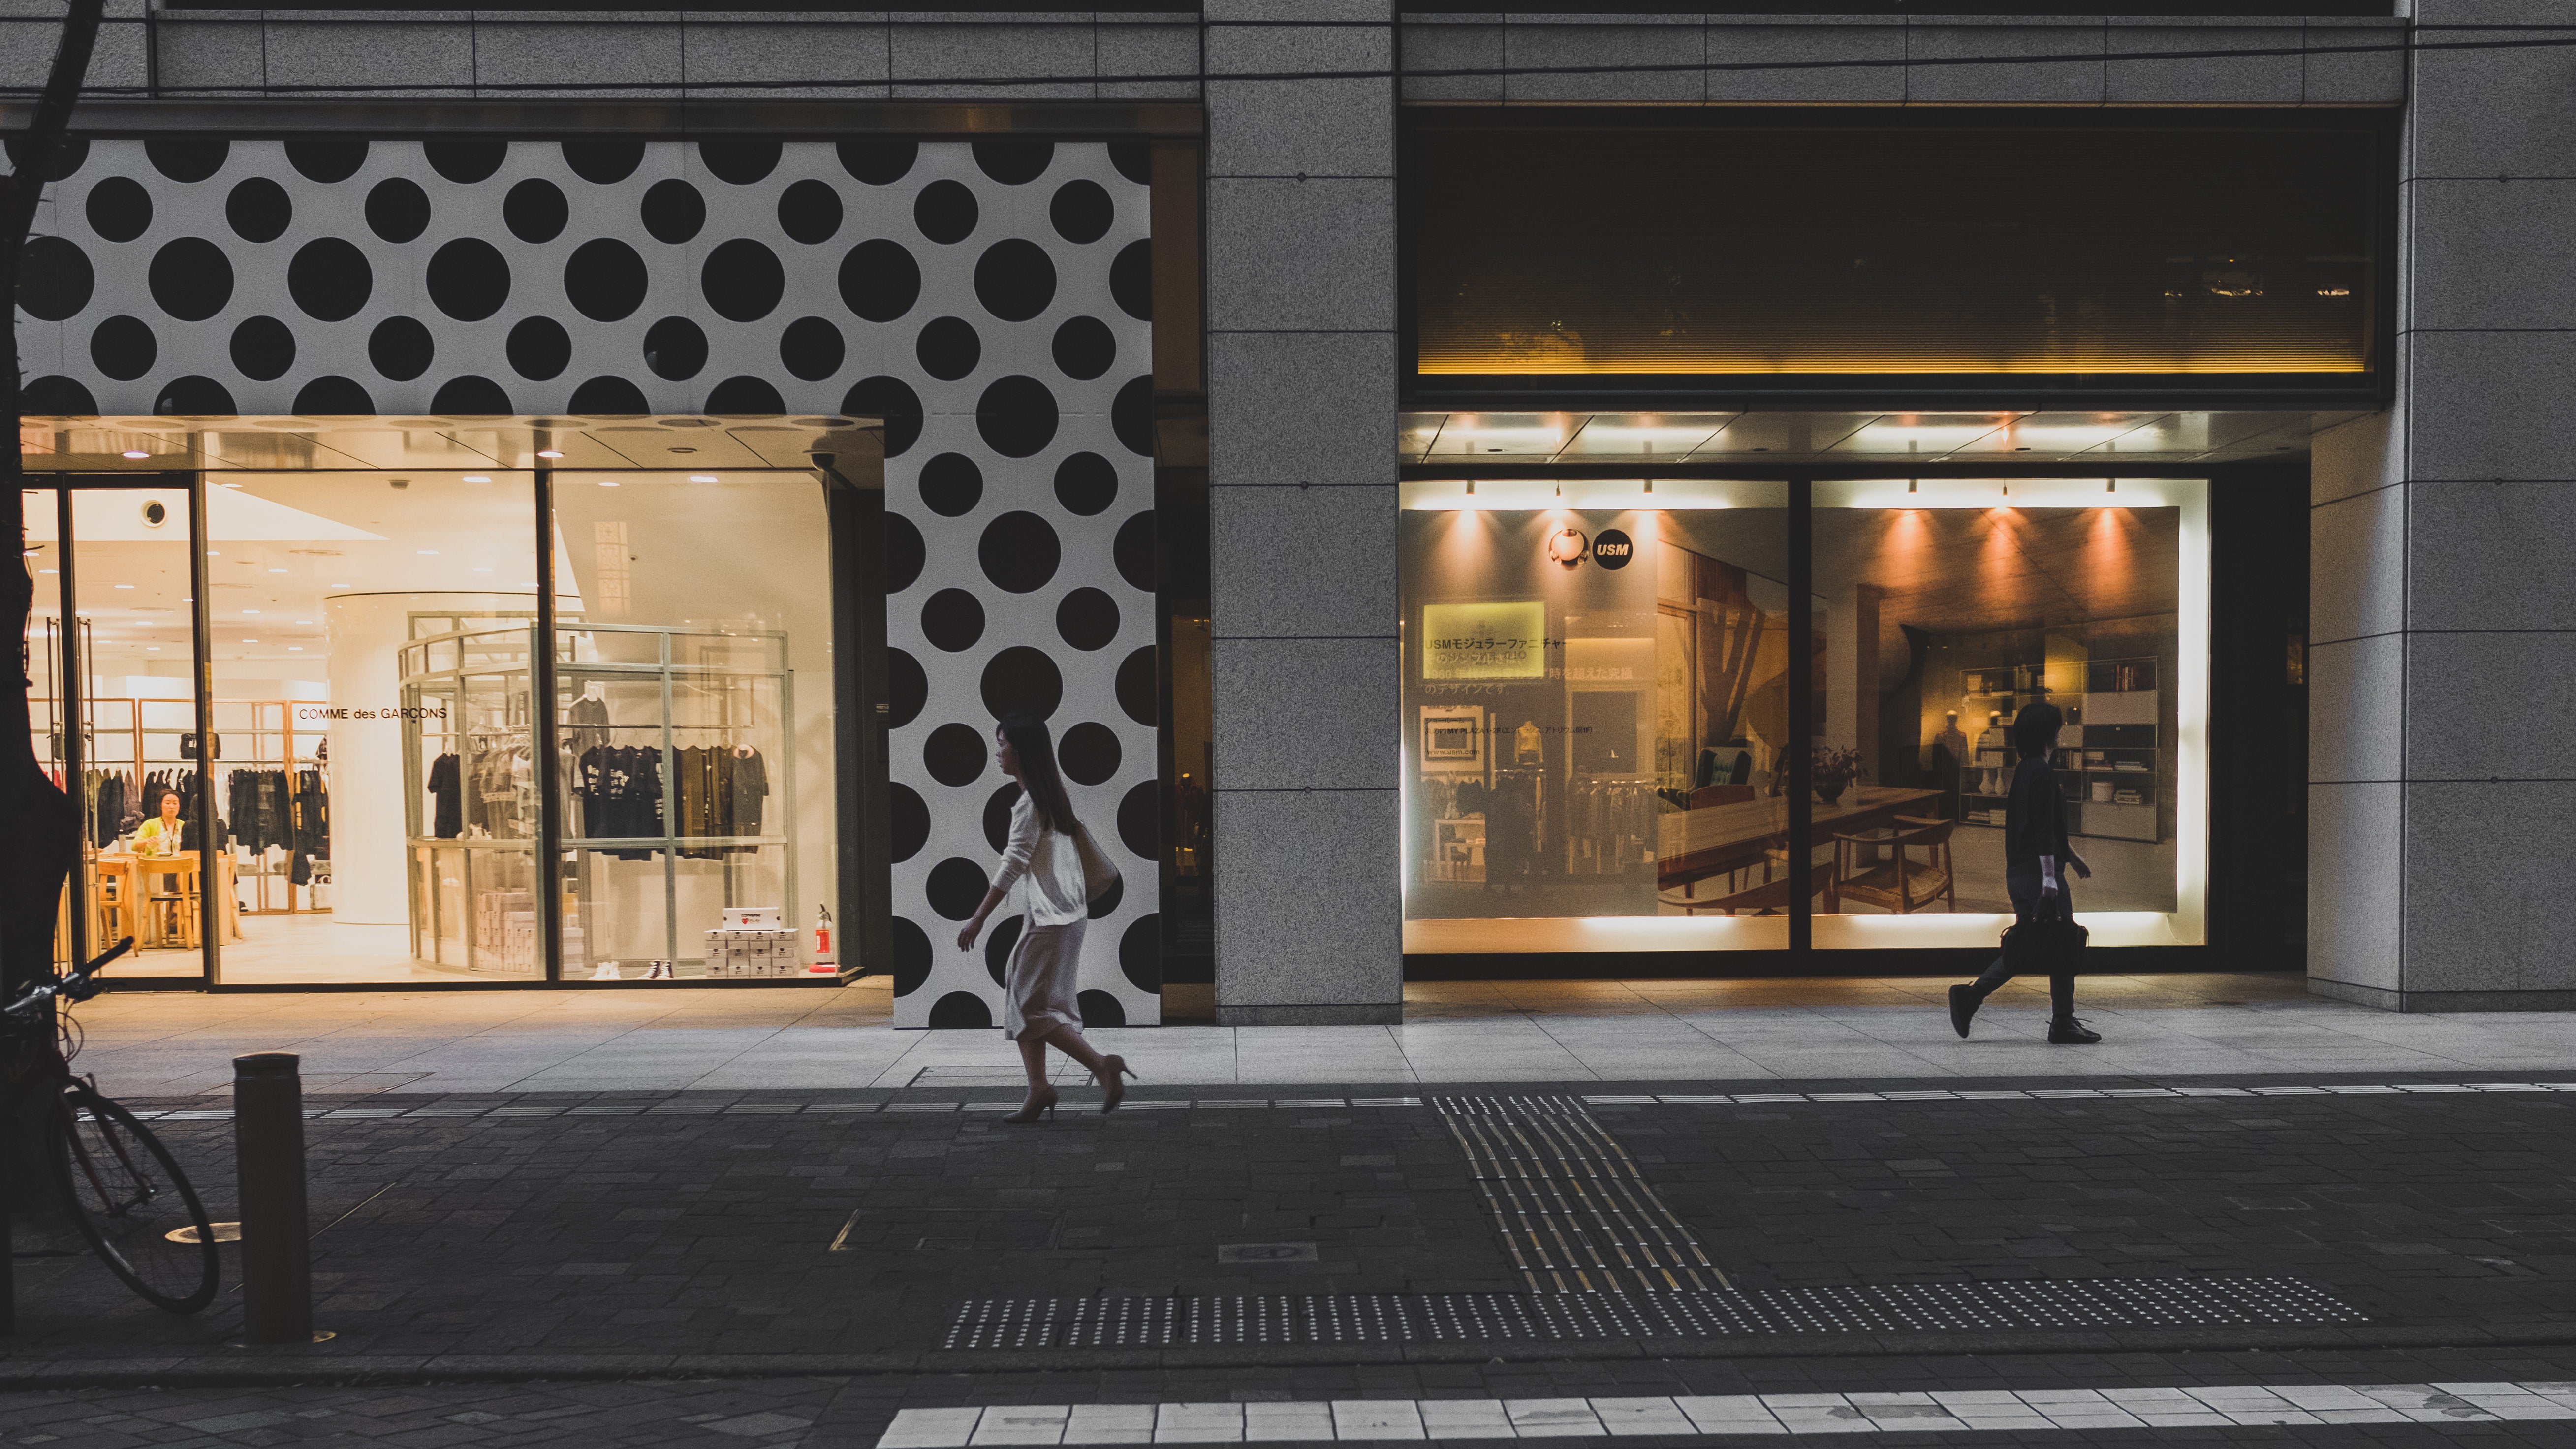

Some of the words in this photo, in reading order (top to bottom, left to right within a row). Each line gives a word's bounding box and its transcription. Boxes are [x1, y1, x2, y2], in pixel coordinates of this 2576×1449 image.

[1597, 544, 1629, 556] USM
[1425, 638, 1573, 649] USMモジュラーファニチャー
[299, 709, 348, 719] COMME
[354, 709, 376, 719] des
[381, 708, 447, 724] GARÇONS
